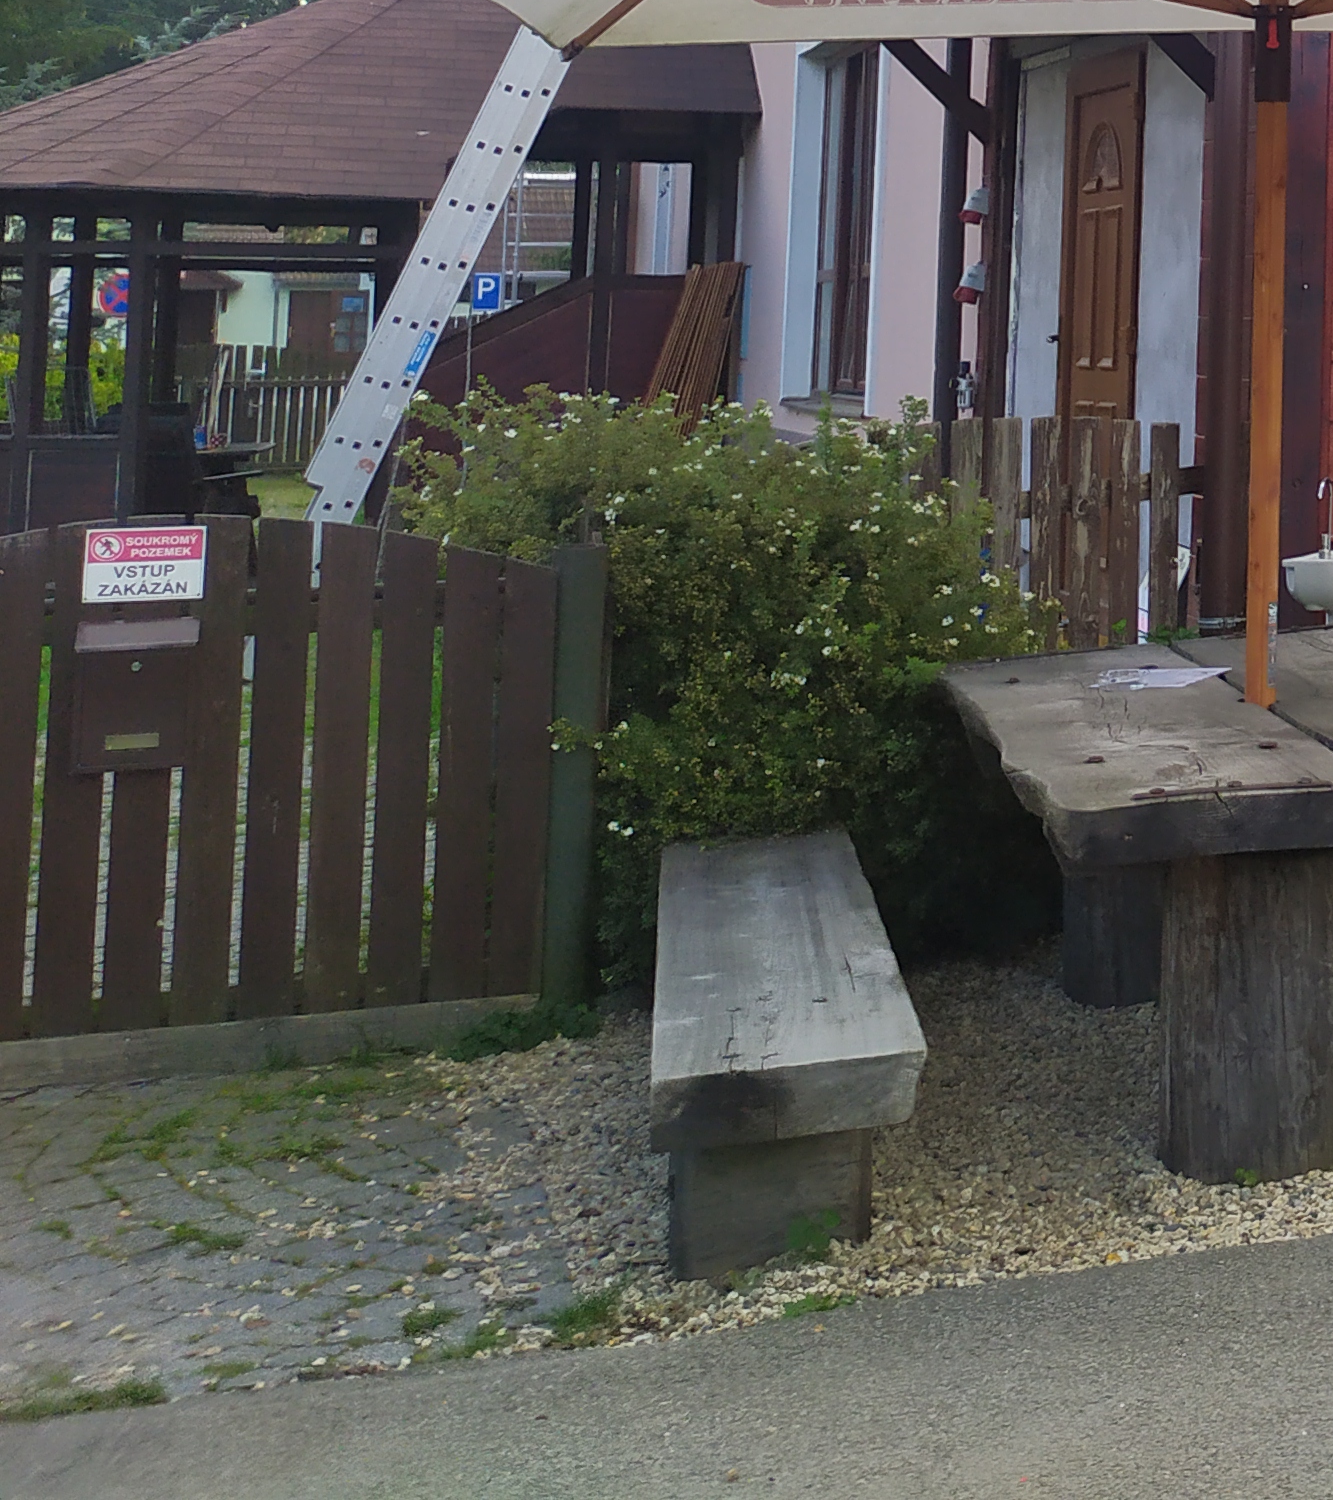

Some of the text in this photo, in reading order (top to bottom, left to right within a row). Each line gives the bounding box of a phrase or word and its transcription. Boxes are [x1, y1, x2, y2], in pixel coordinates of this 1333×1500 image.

[477, 278, 496, 300] P
[126, 533, 198, 546] SOUKROMÝ
[130, 546, 192, 558] POZEMEK
[113, 564, 175, 578] VSTUP
[97, 580, 188, 597] ZAKÁZÁN
